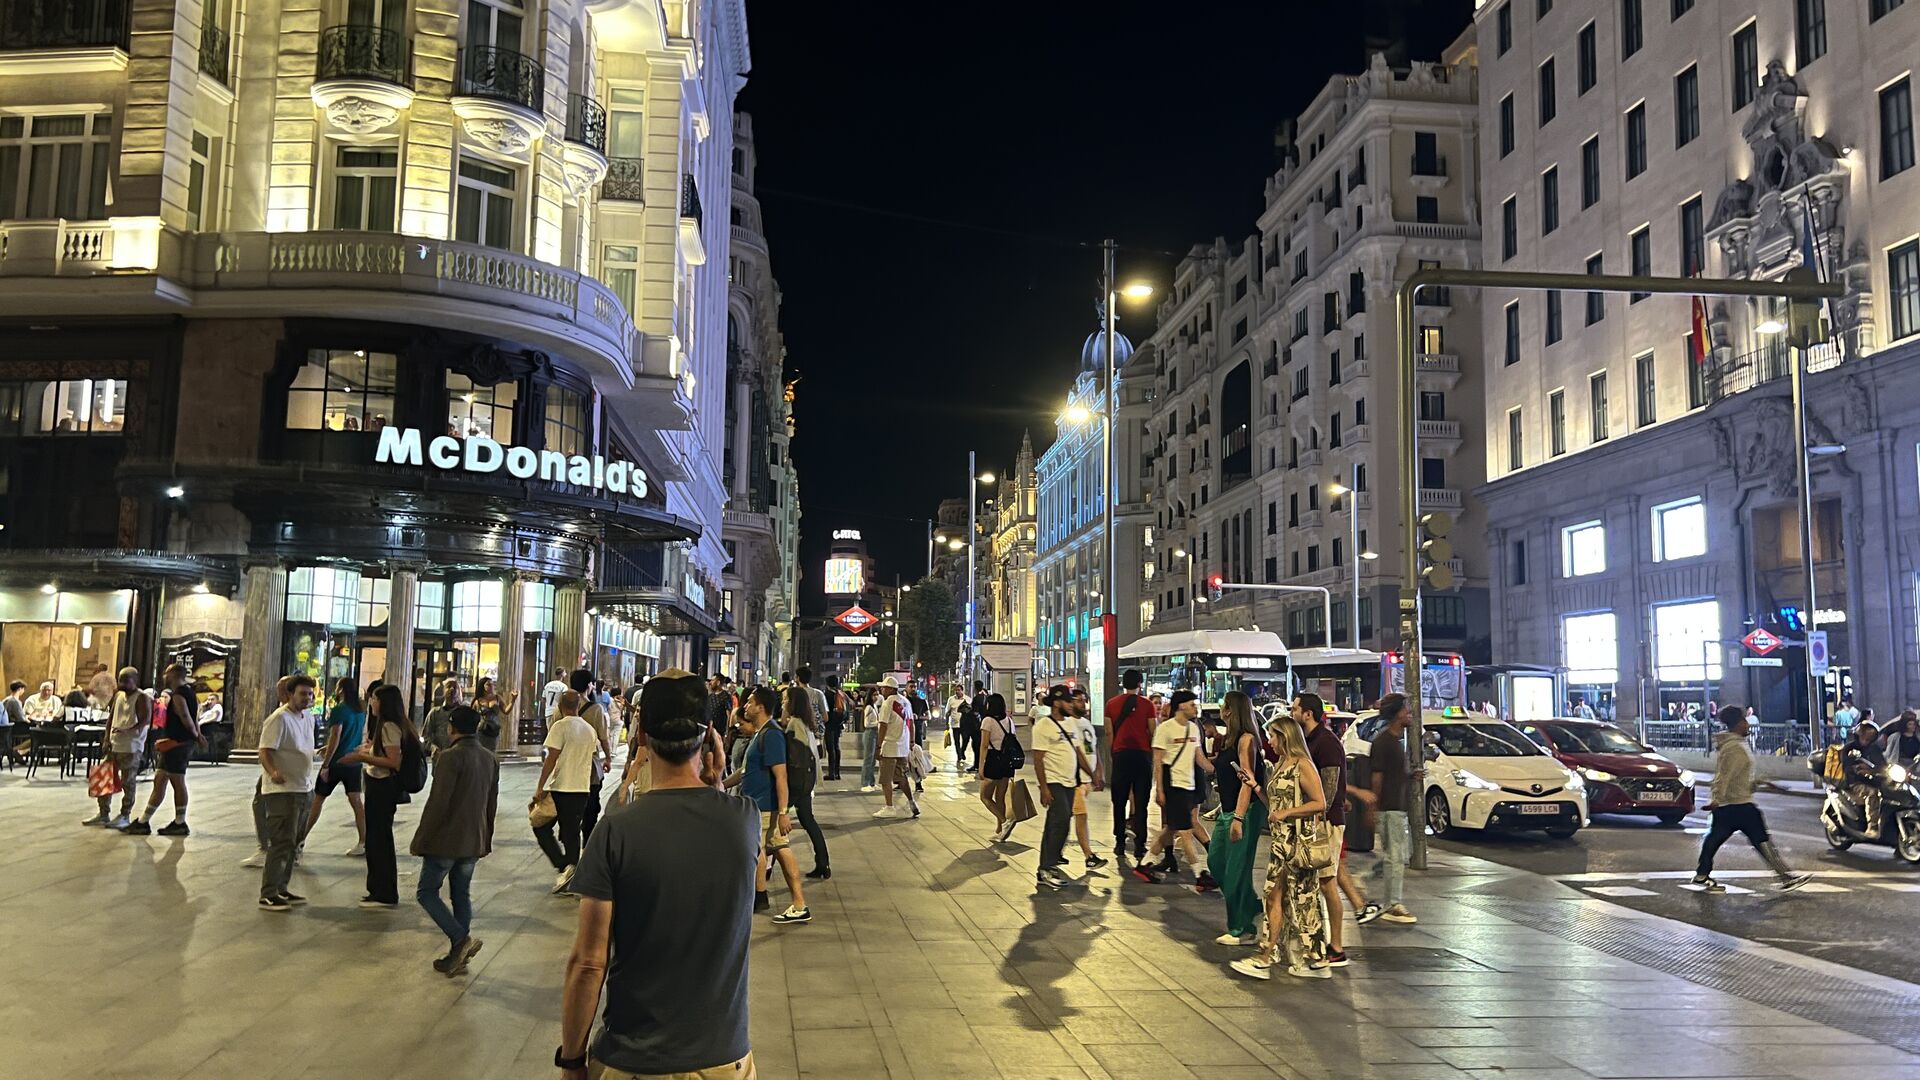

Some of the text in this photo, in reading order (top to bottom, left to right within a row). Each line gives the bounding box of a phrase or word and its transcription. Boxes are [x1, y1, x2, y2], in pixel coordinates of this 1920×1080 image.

[375, 425, 648, 499] McDonald's
[832, 529, 861, 540] CPITOL
[846, 615, 866, 624] Metro
[547, 691, 556, 706] 7
